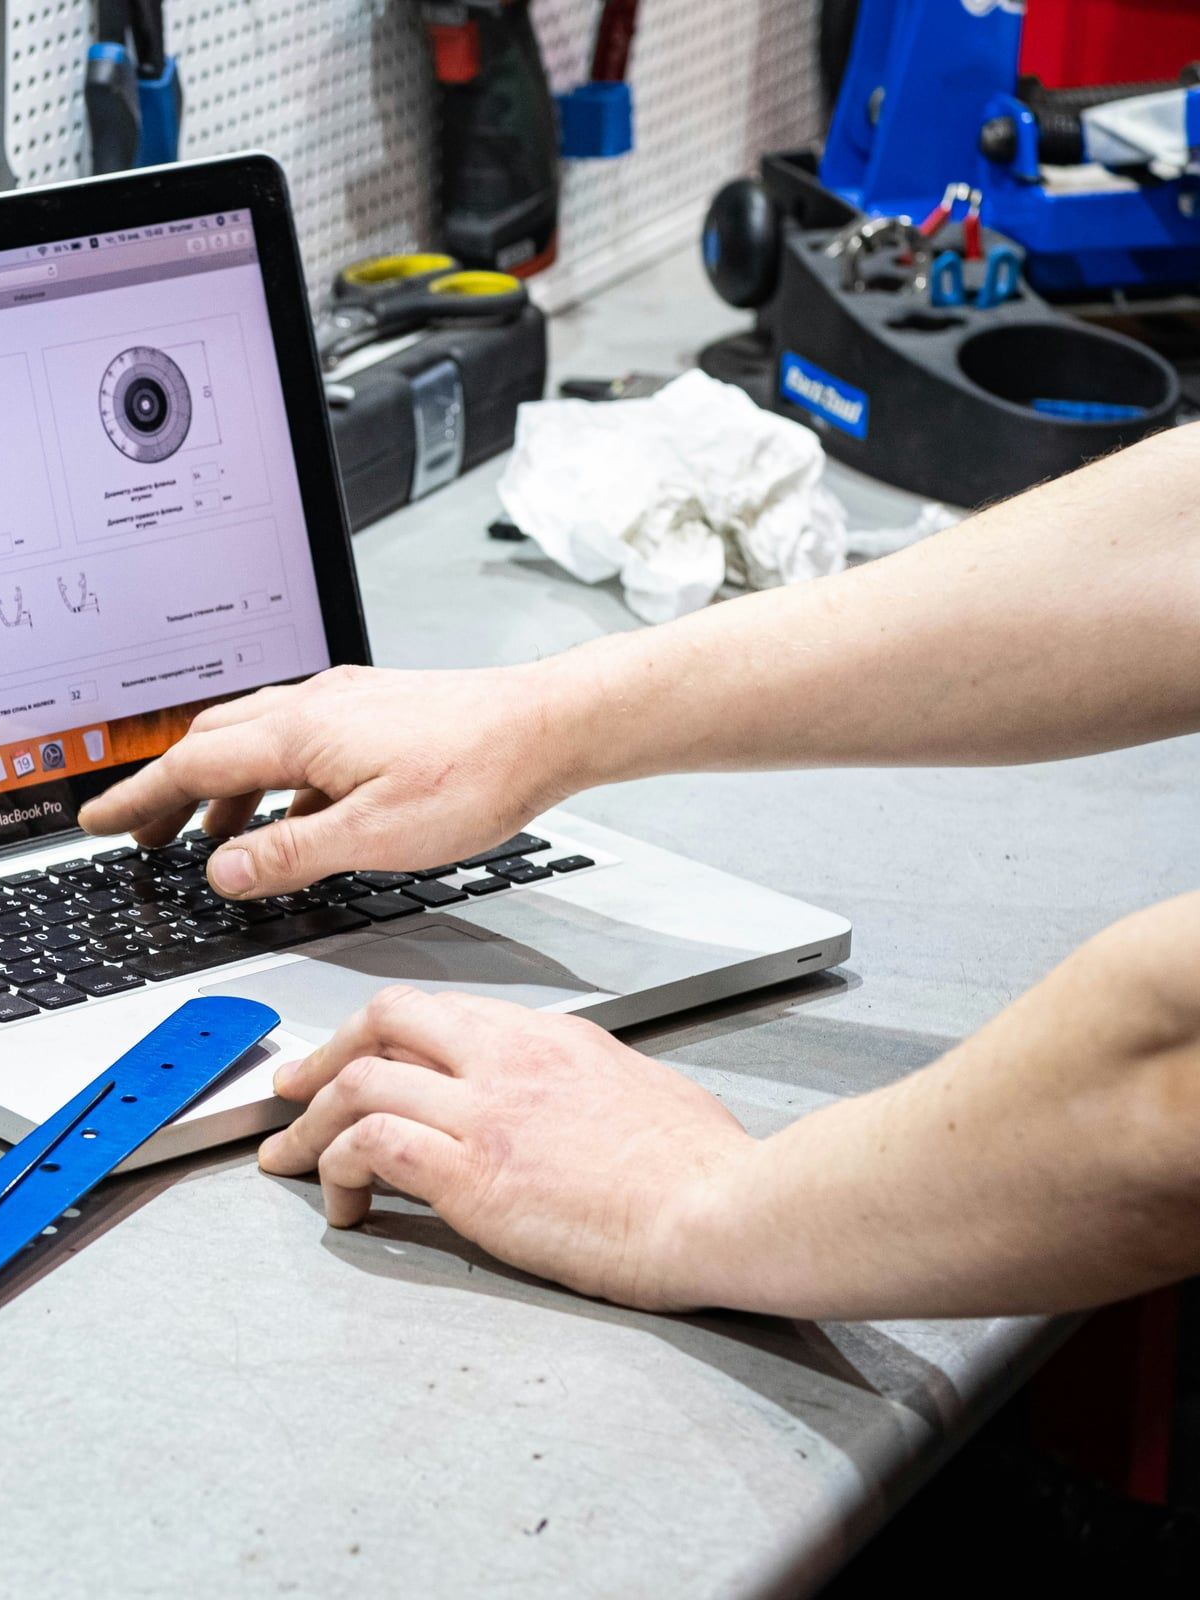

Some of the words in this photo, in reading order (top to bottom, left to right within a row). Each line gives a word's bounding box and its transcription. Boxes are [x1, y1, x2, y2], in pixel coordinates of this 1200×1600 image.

[71, 690, 81, 701] 32
[12, 704, 27, 714] спиц
[16, 756, 31, 771] 19
[43, 800, 63, 816] Pro
[93, 982, 113, 992] cmd
